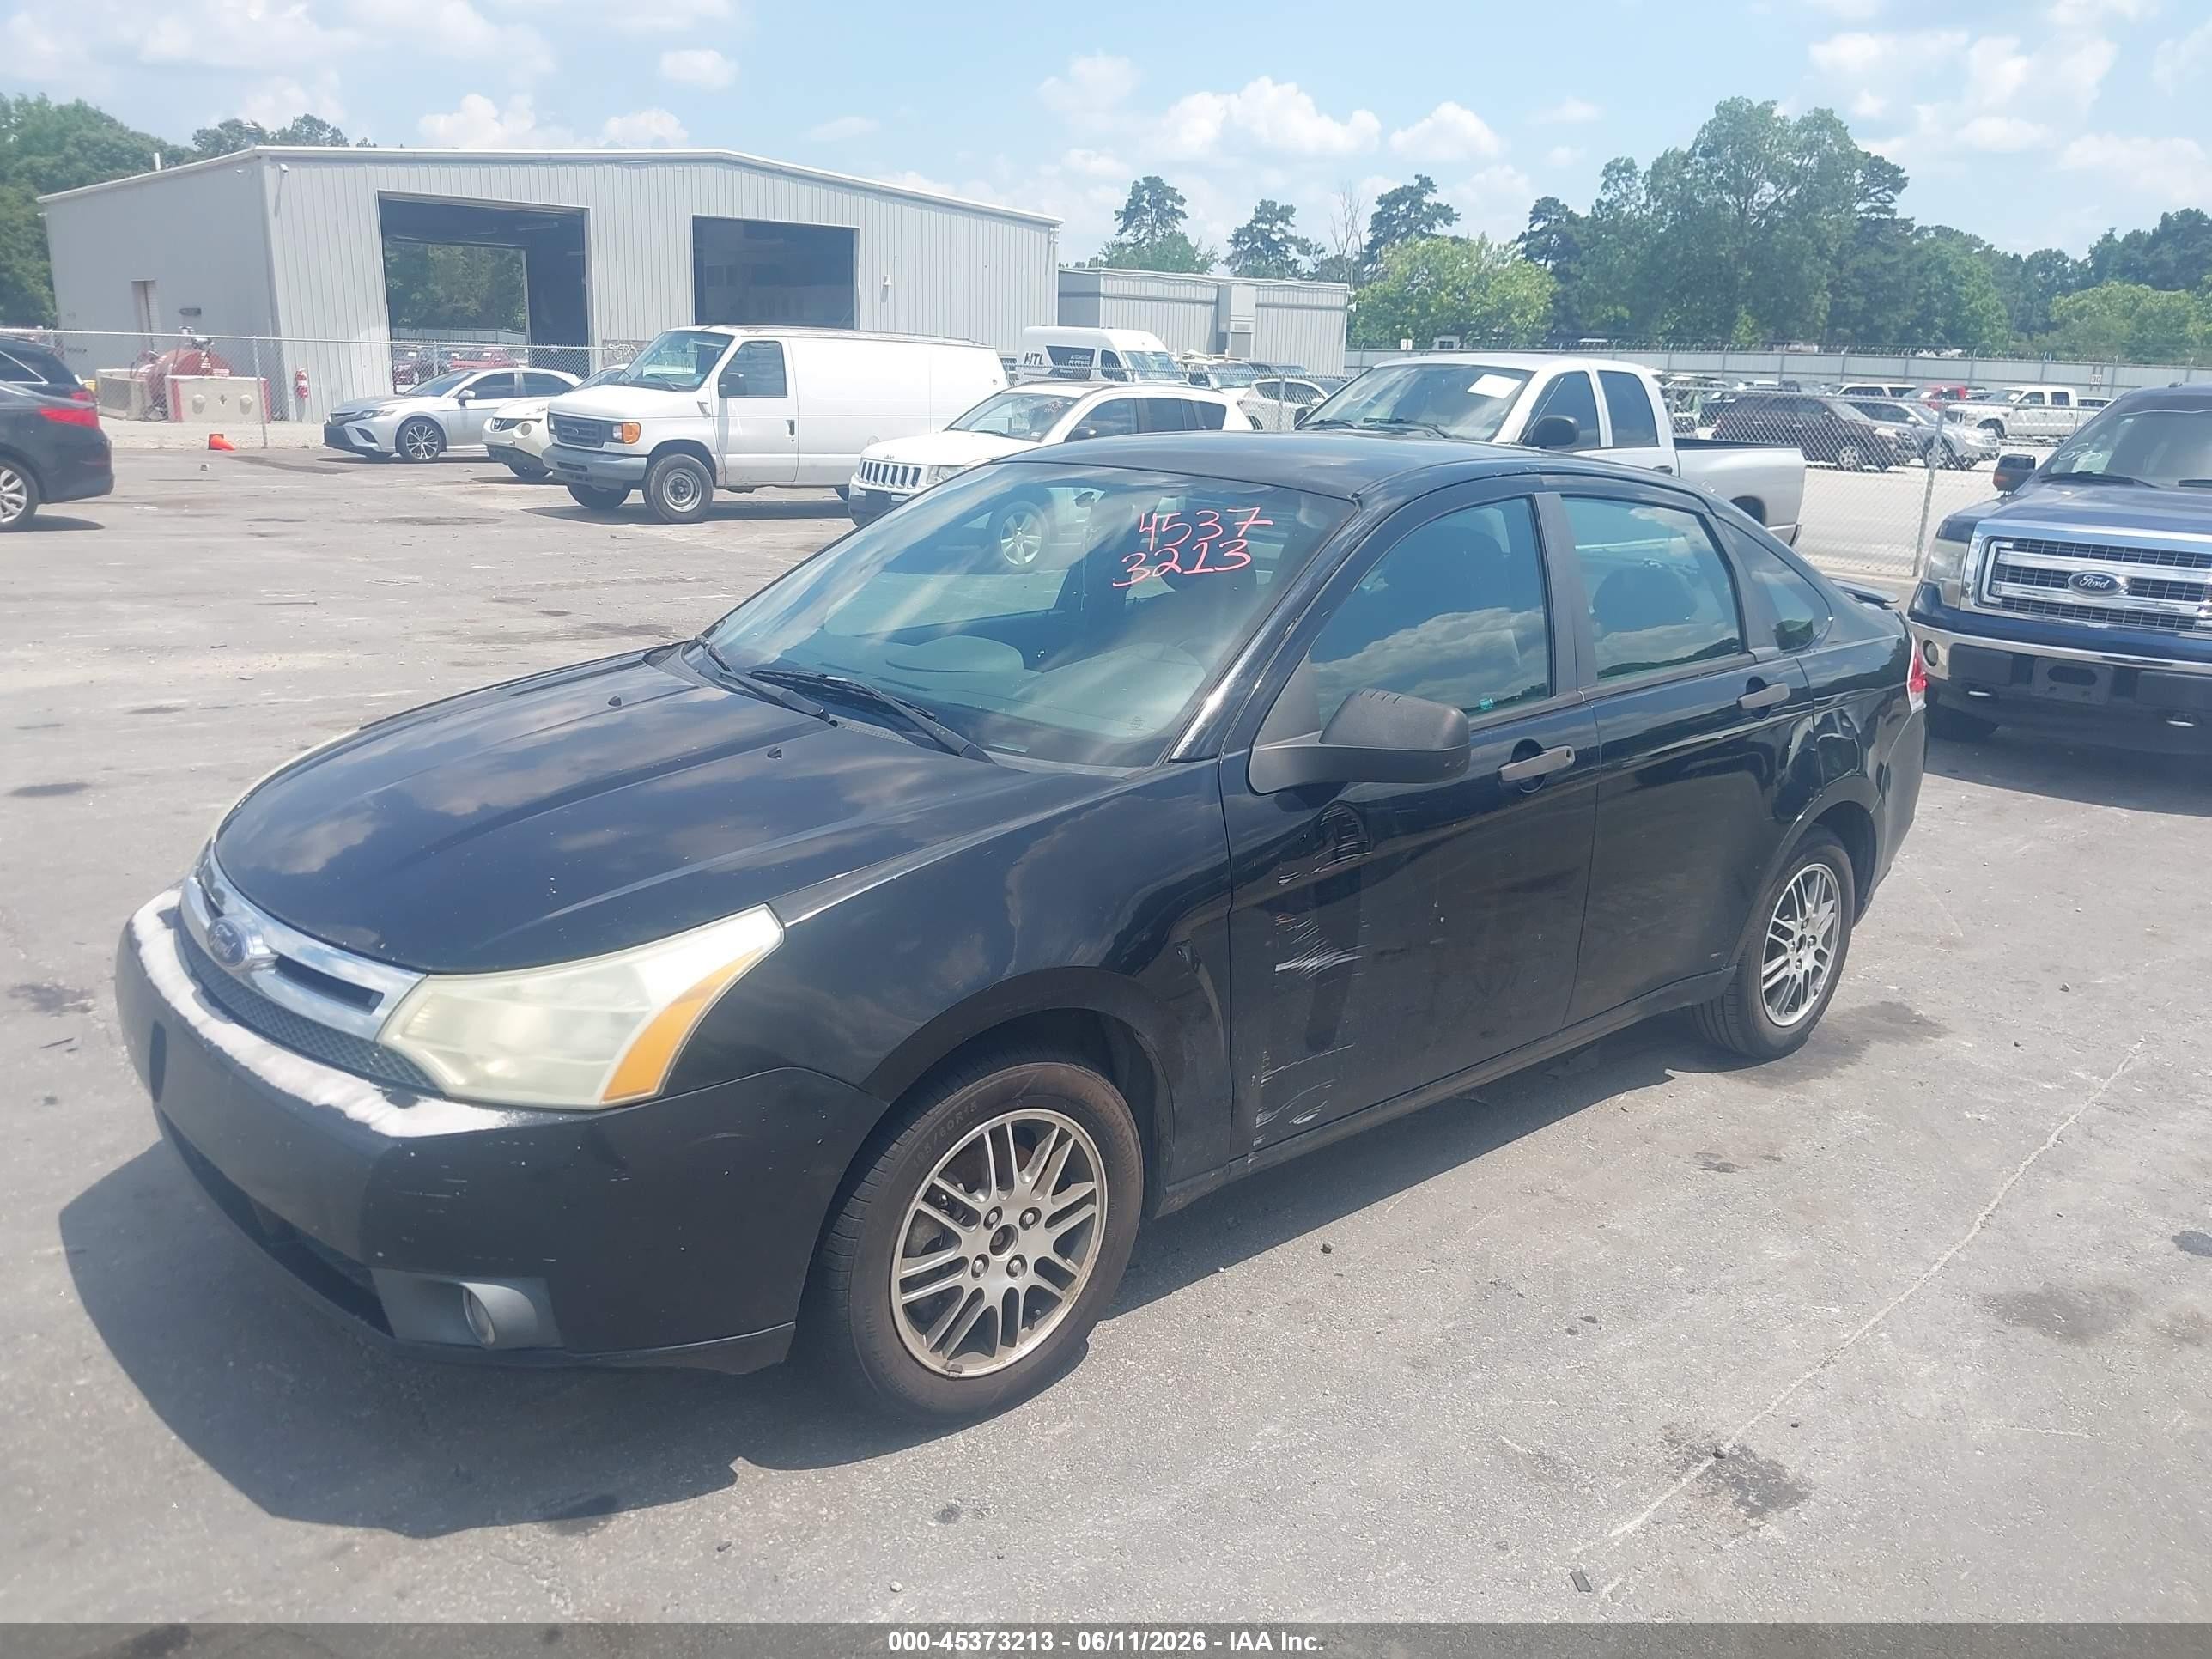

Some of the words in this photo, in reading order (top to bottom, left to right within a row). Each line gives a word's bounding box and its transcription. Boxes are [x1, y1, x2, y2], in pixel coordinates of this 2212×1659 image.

[1139, 507, 1274, 551] 4537
[1112, 538, 1252, 587] 3213
[2079, 574, 2110, 589] Ford
[210, 923, 237, 959] Ford
